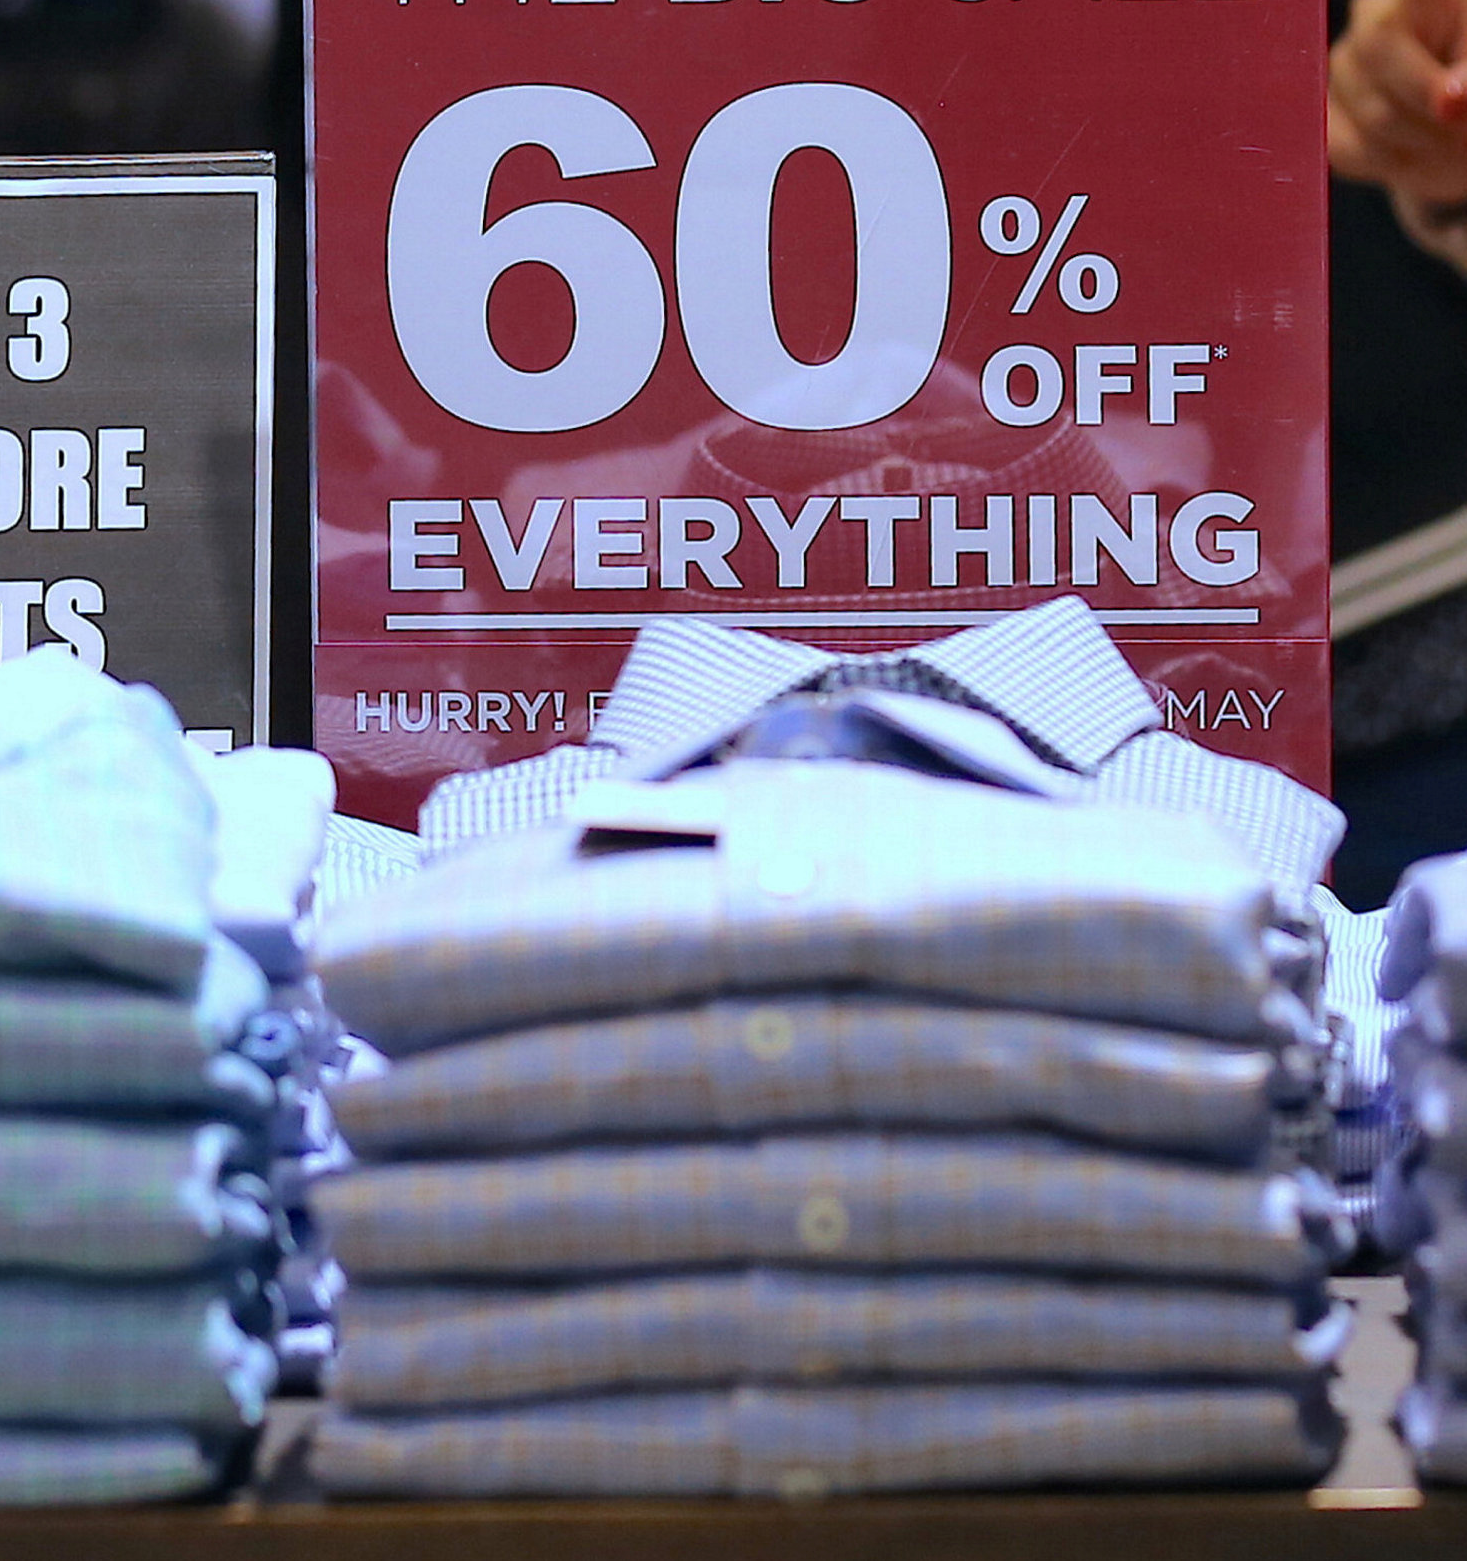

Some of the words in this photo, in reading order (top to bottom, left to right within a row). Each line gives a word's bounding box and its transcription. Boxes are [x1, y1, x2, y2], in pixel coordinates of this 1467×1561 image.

[6, 276, 72, 381] 3
[385, 490, 1262, 593] EVERYTHING
[354, 690, 567, 733] HURRY!
[1165, 689, 1285, 731] MAY
